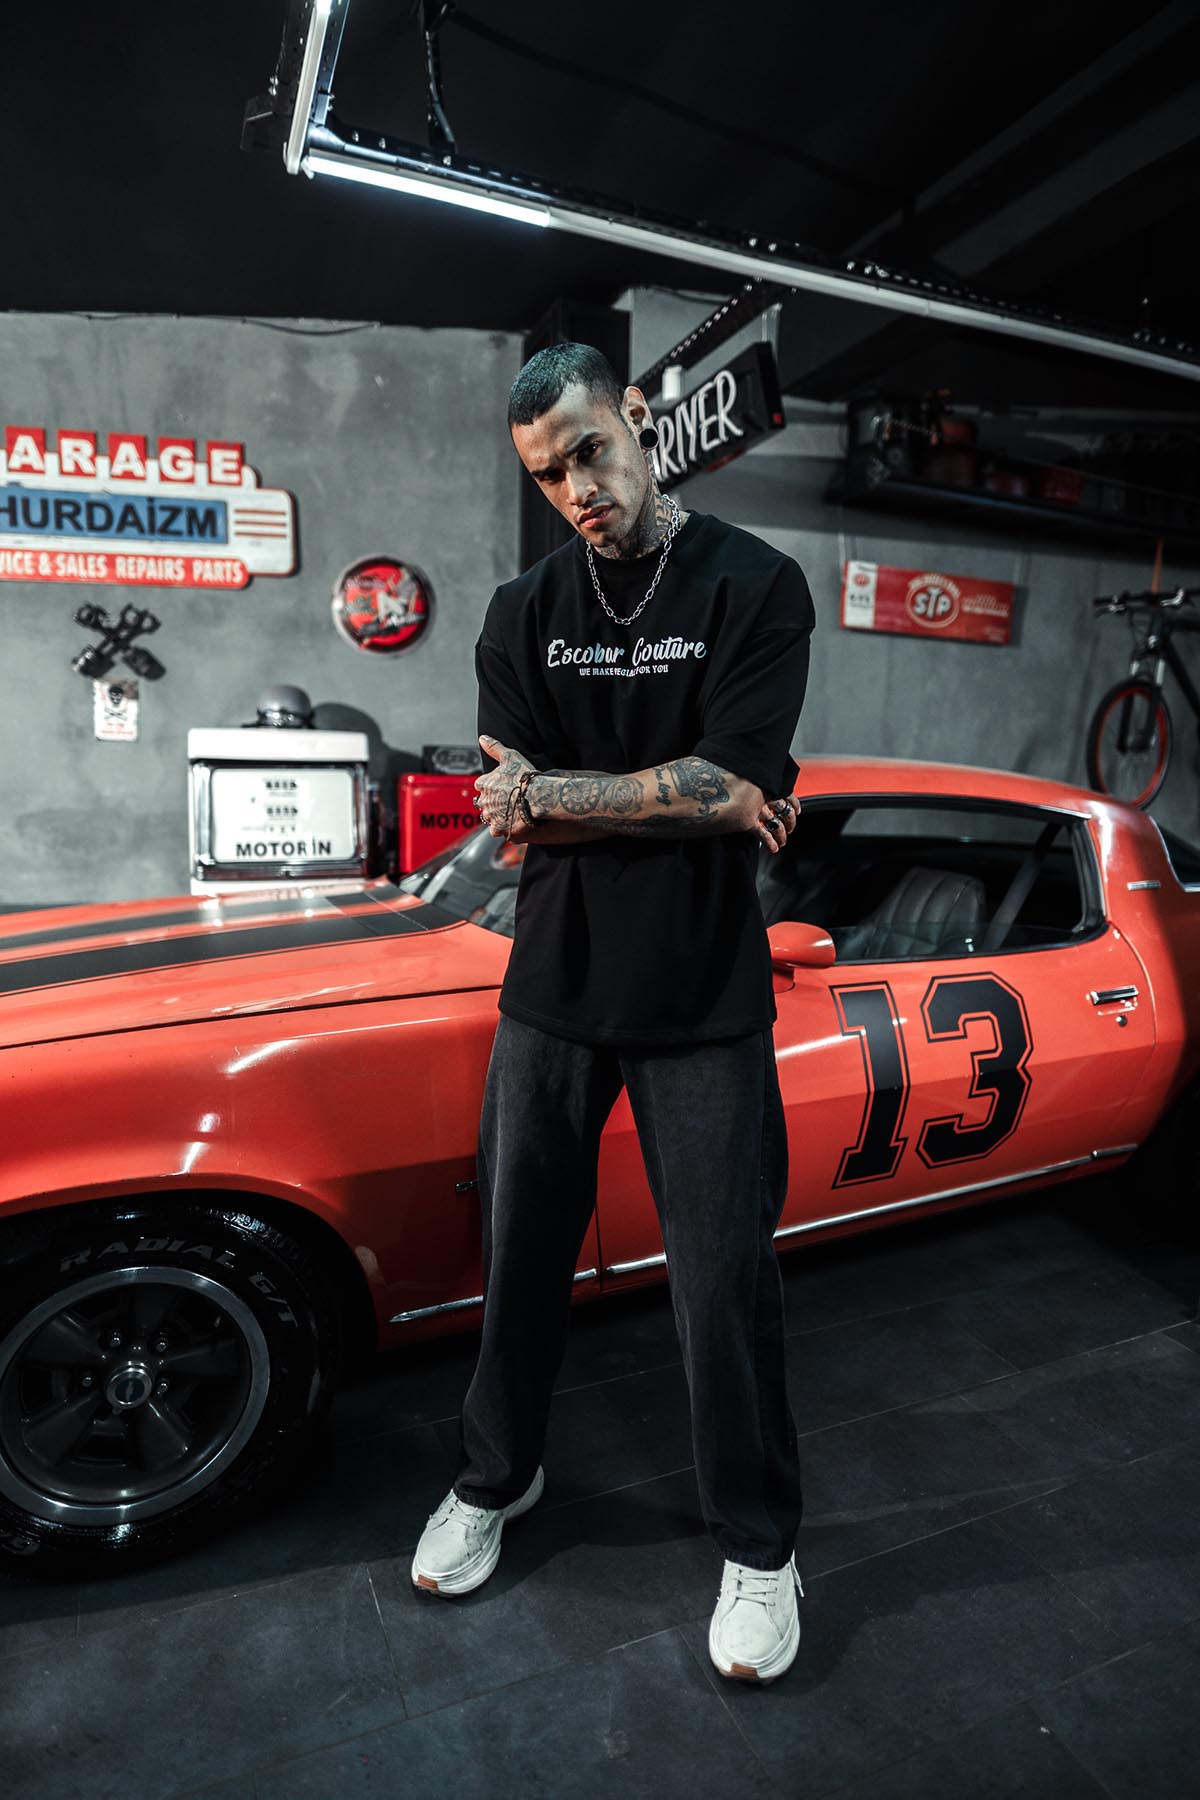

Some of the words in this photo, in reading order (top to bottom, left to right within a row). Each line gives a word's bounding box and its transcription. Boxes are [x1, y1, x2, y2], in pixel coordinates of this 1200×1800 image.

[8, 434, 241, 484] ARAGE
[39, 552, 52, 576] &
[55, 553, 107, 578] SALES
[115, 556, 185, 582] REPAIRS
[192, 559, 243, 584] PARTS
[913, 587, 951, 619] STP
[631, 636, 707, 667] Couture
[579, 667, 591, 676] WE
[592, 667, 614, 676] MAKE
[652, 664, 669, 673] YOU
[829, 971, 1034, 1190] 13
[59, 1237, 238, 1272] RADIAL
